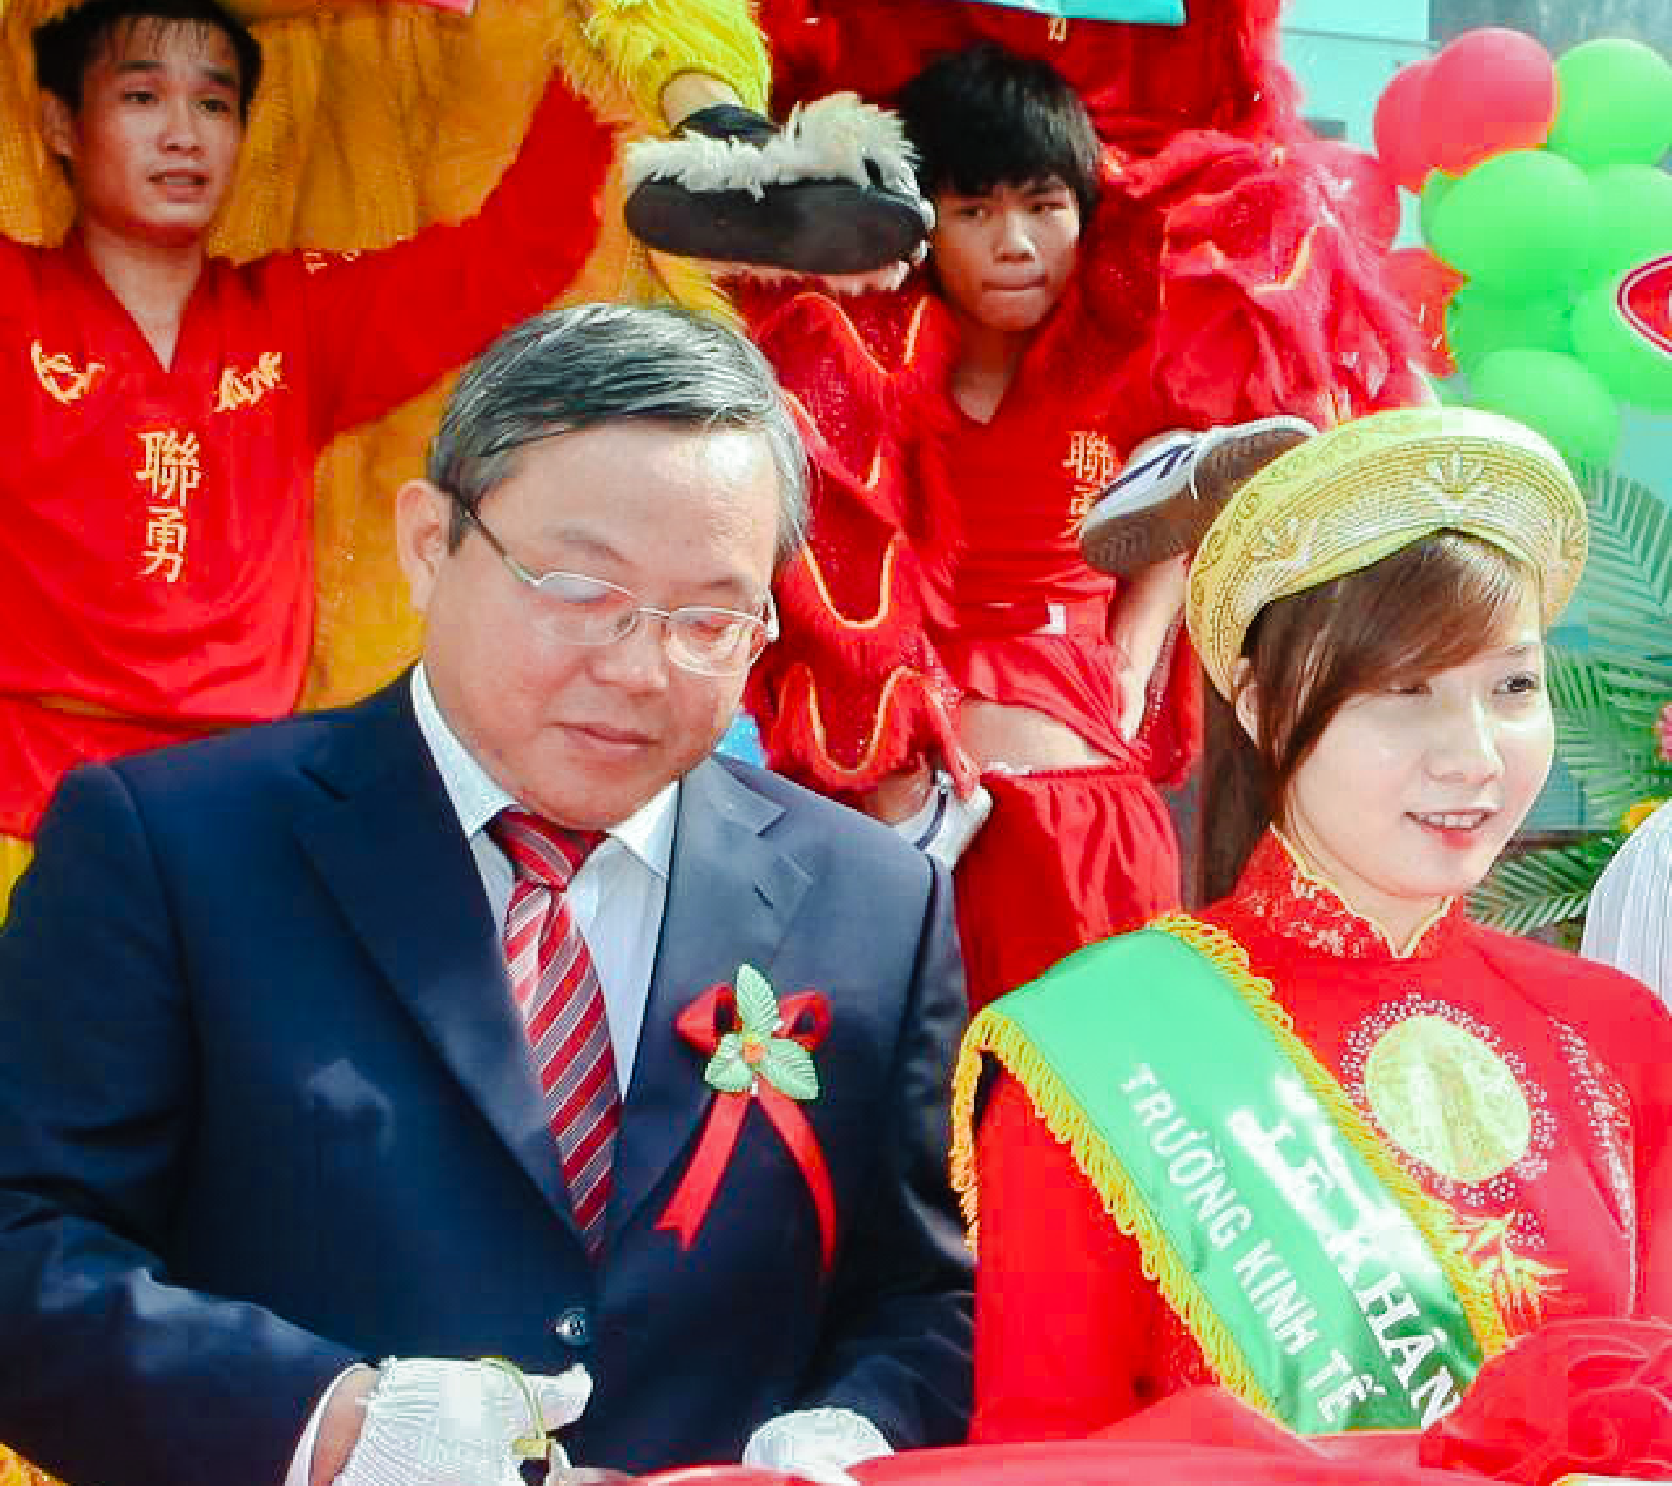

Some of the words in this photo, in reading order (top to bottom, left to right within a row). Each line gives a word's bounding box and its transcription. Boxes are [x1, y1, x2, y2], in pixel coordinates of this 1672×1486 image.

[1119, 1062, 1254, 1252] TRƯỜNG
[1232, 1238, 1320, 1357] KINH
[1304, 1349, 1388, 1424] TẾ
